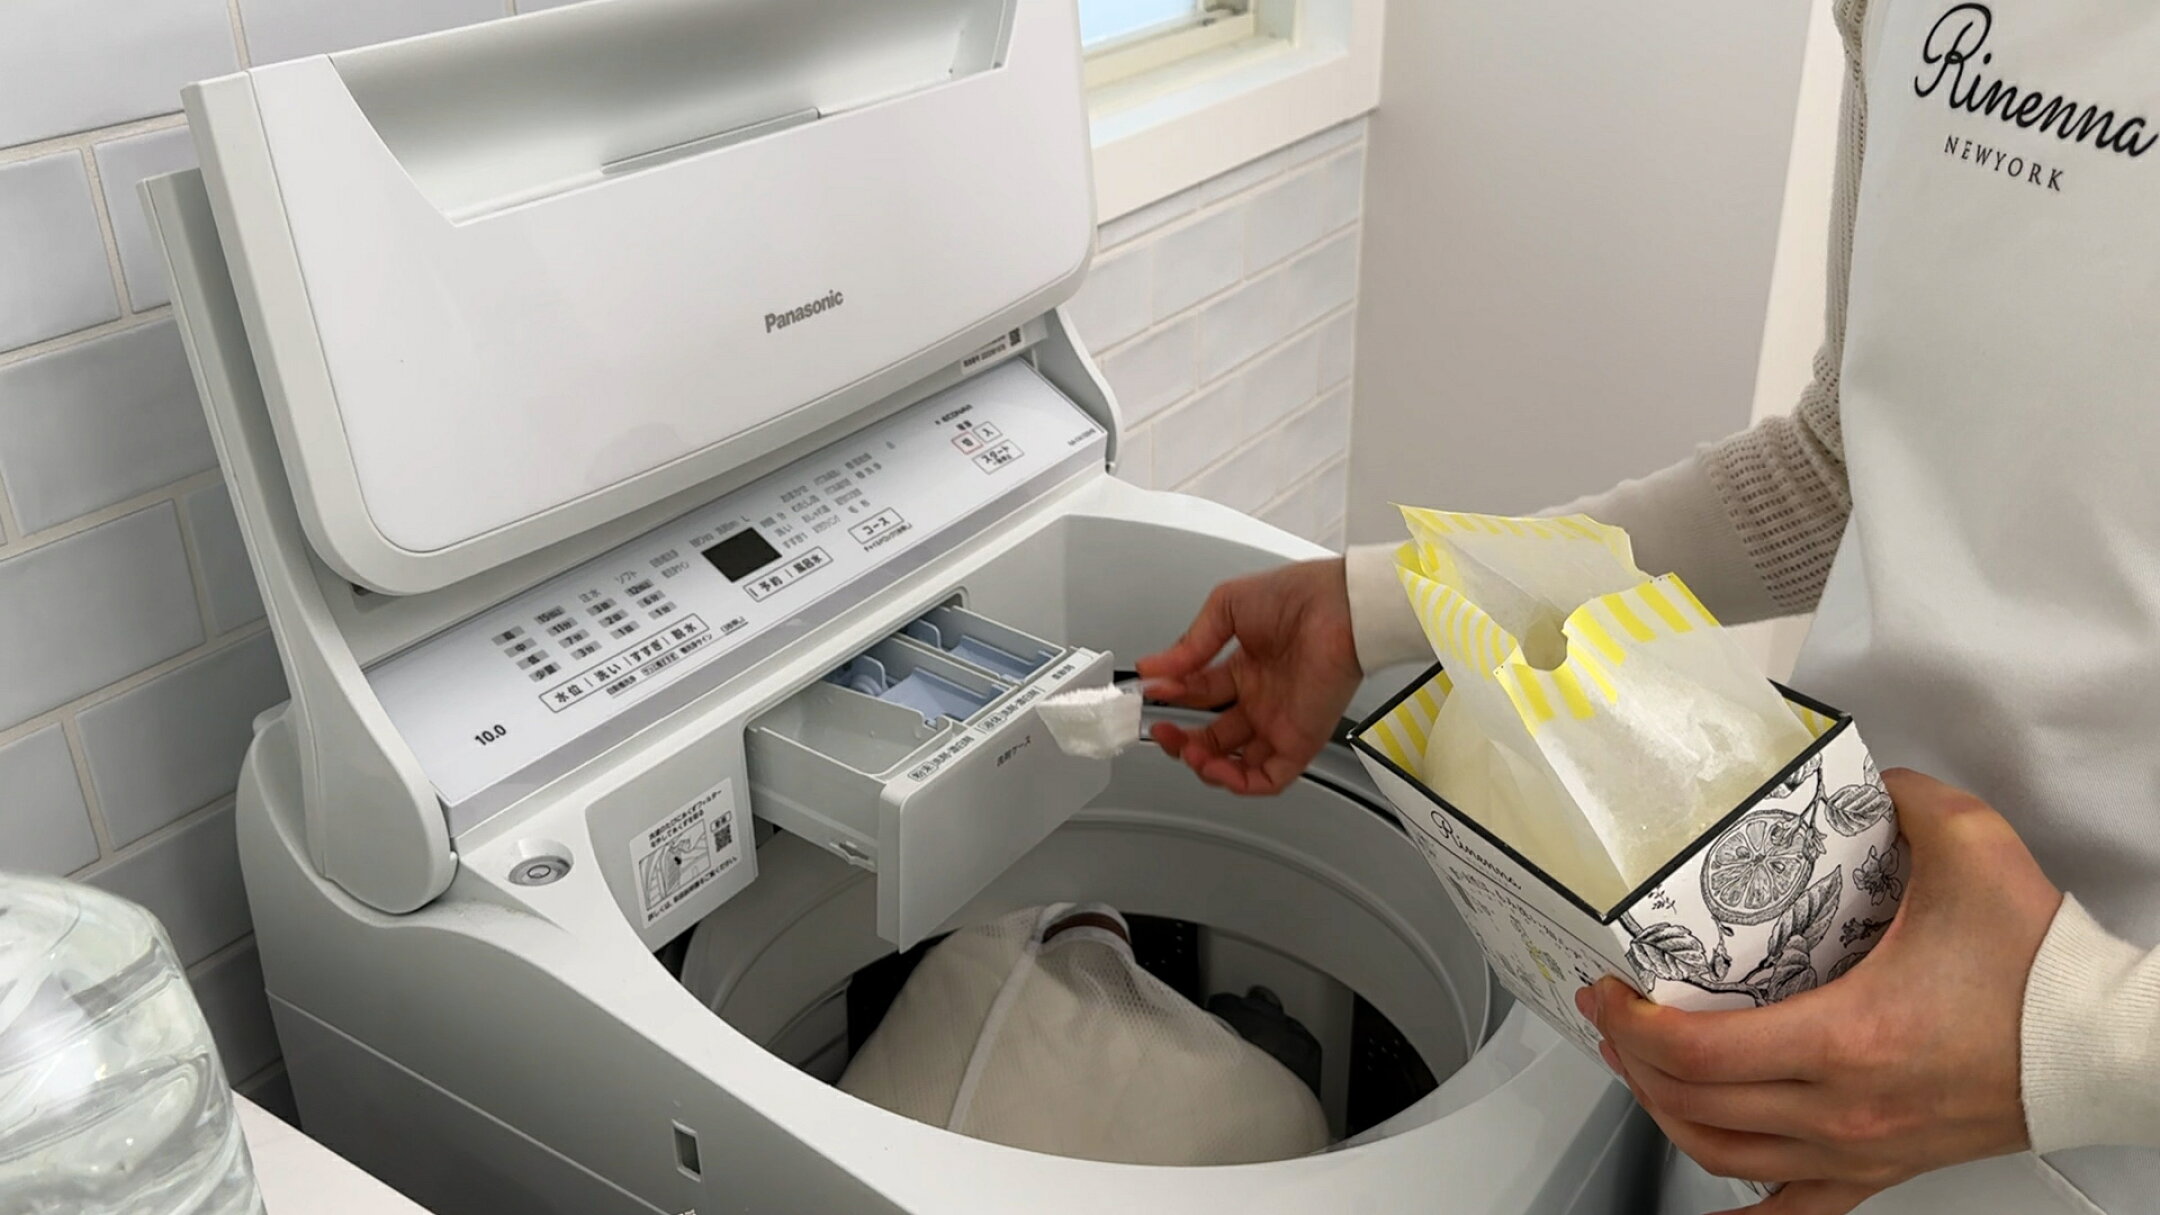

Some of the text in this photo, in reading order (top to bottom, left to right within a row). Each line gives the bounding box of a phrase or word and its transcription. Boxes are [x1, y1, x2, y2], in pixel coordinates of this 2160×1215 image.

[1914, 2, 2159, 157] Rinenna
[764, 289, 844, 334] Panasonic
[982, 427, 994, 438] 入
[981, 445, 1010, 465] スタート
[861, 515, 891, 536] コース
[757, 553, 824, 593] 予約 風呂水
[552, 620, 572, 634] 11分
[514, 642, 527, 652] 中
[565, 632, 583, 645] 7分
[577, 645, 596, 658] 3分
[535, 663, 558, 680] 少量
[554, 622, 698, 703] 水位 洗い すすぎ 脱水
[473, 723, 508, 747] 10.0
